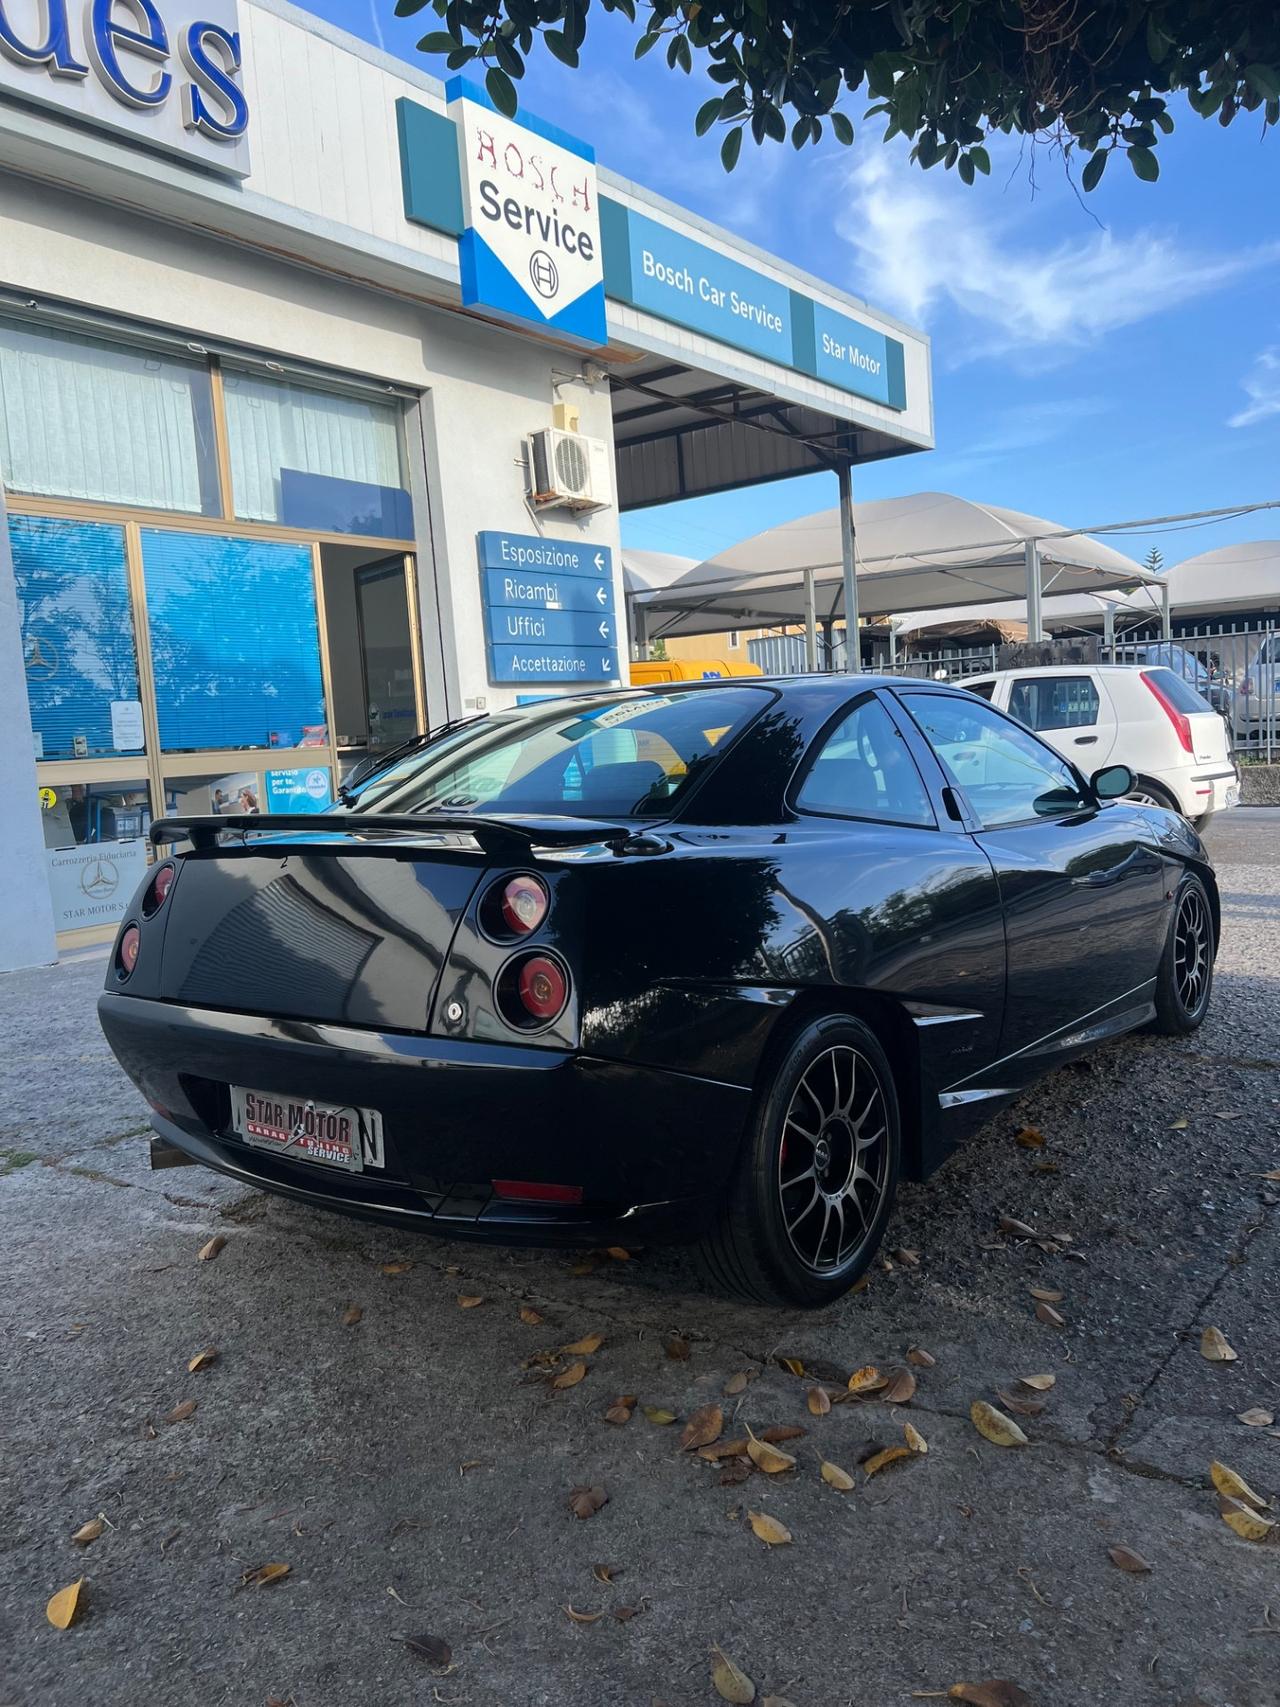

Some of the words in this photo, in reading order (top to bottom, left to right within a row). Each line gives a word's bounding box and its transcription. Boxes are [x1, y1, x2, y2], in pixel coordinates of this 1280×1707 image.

[479, 179, 594, 261] Service
[642, 250, 694, 295] Bosch
[699, 277, 725, 308] Car
[730, 292, 783, 333] Service
[822, 333, 846, 358] Star
[849, 347, 881, 376] Motor
[501, 541, 580, 569] Esposizione
[504, 578, 559, 601] Ricambi
[507, 616, 545, 637] Uffici
[512, 655, 586, 672] Accettazione
[51, 856, 97, 867] Carrozzeria
[63, 909, 86, 919] STAR
[87, 903, 117, 915] MOTOR
[246, 1093, 283, 1128] STAR
[288, 1104, 350, 1142] MOTOR
[248, 1124, 287, 1140] GARAG
[307, 1145, 350, 1163] SERVICE
